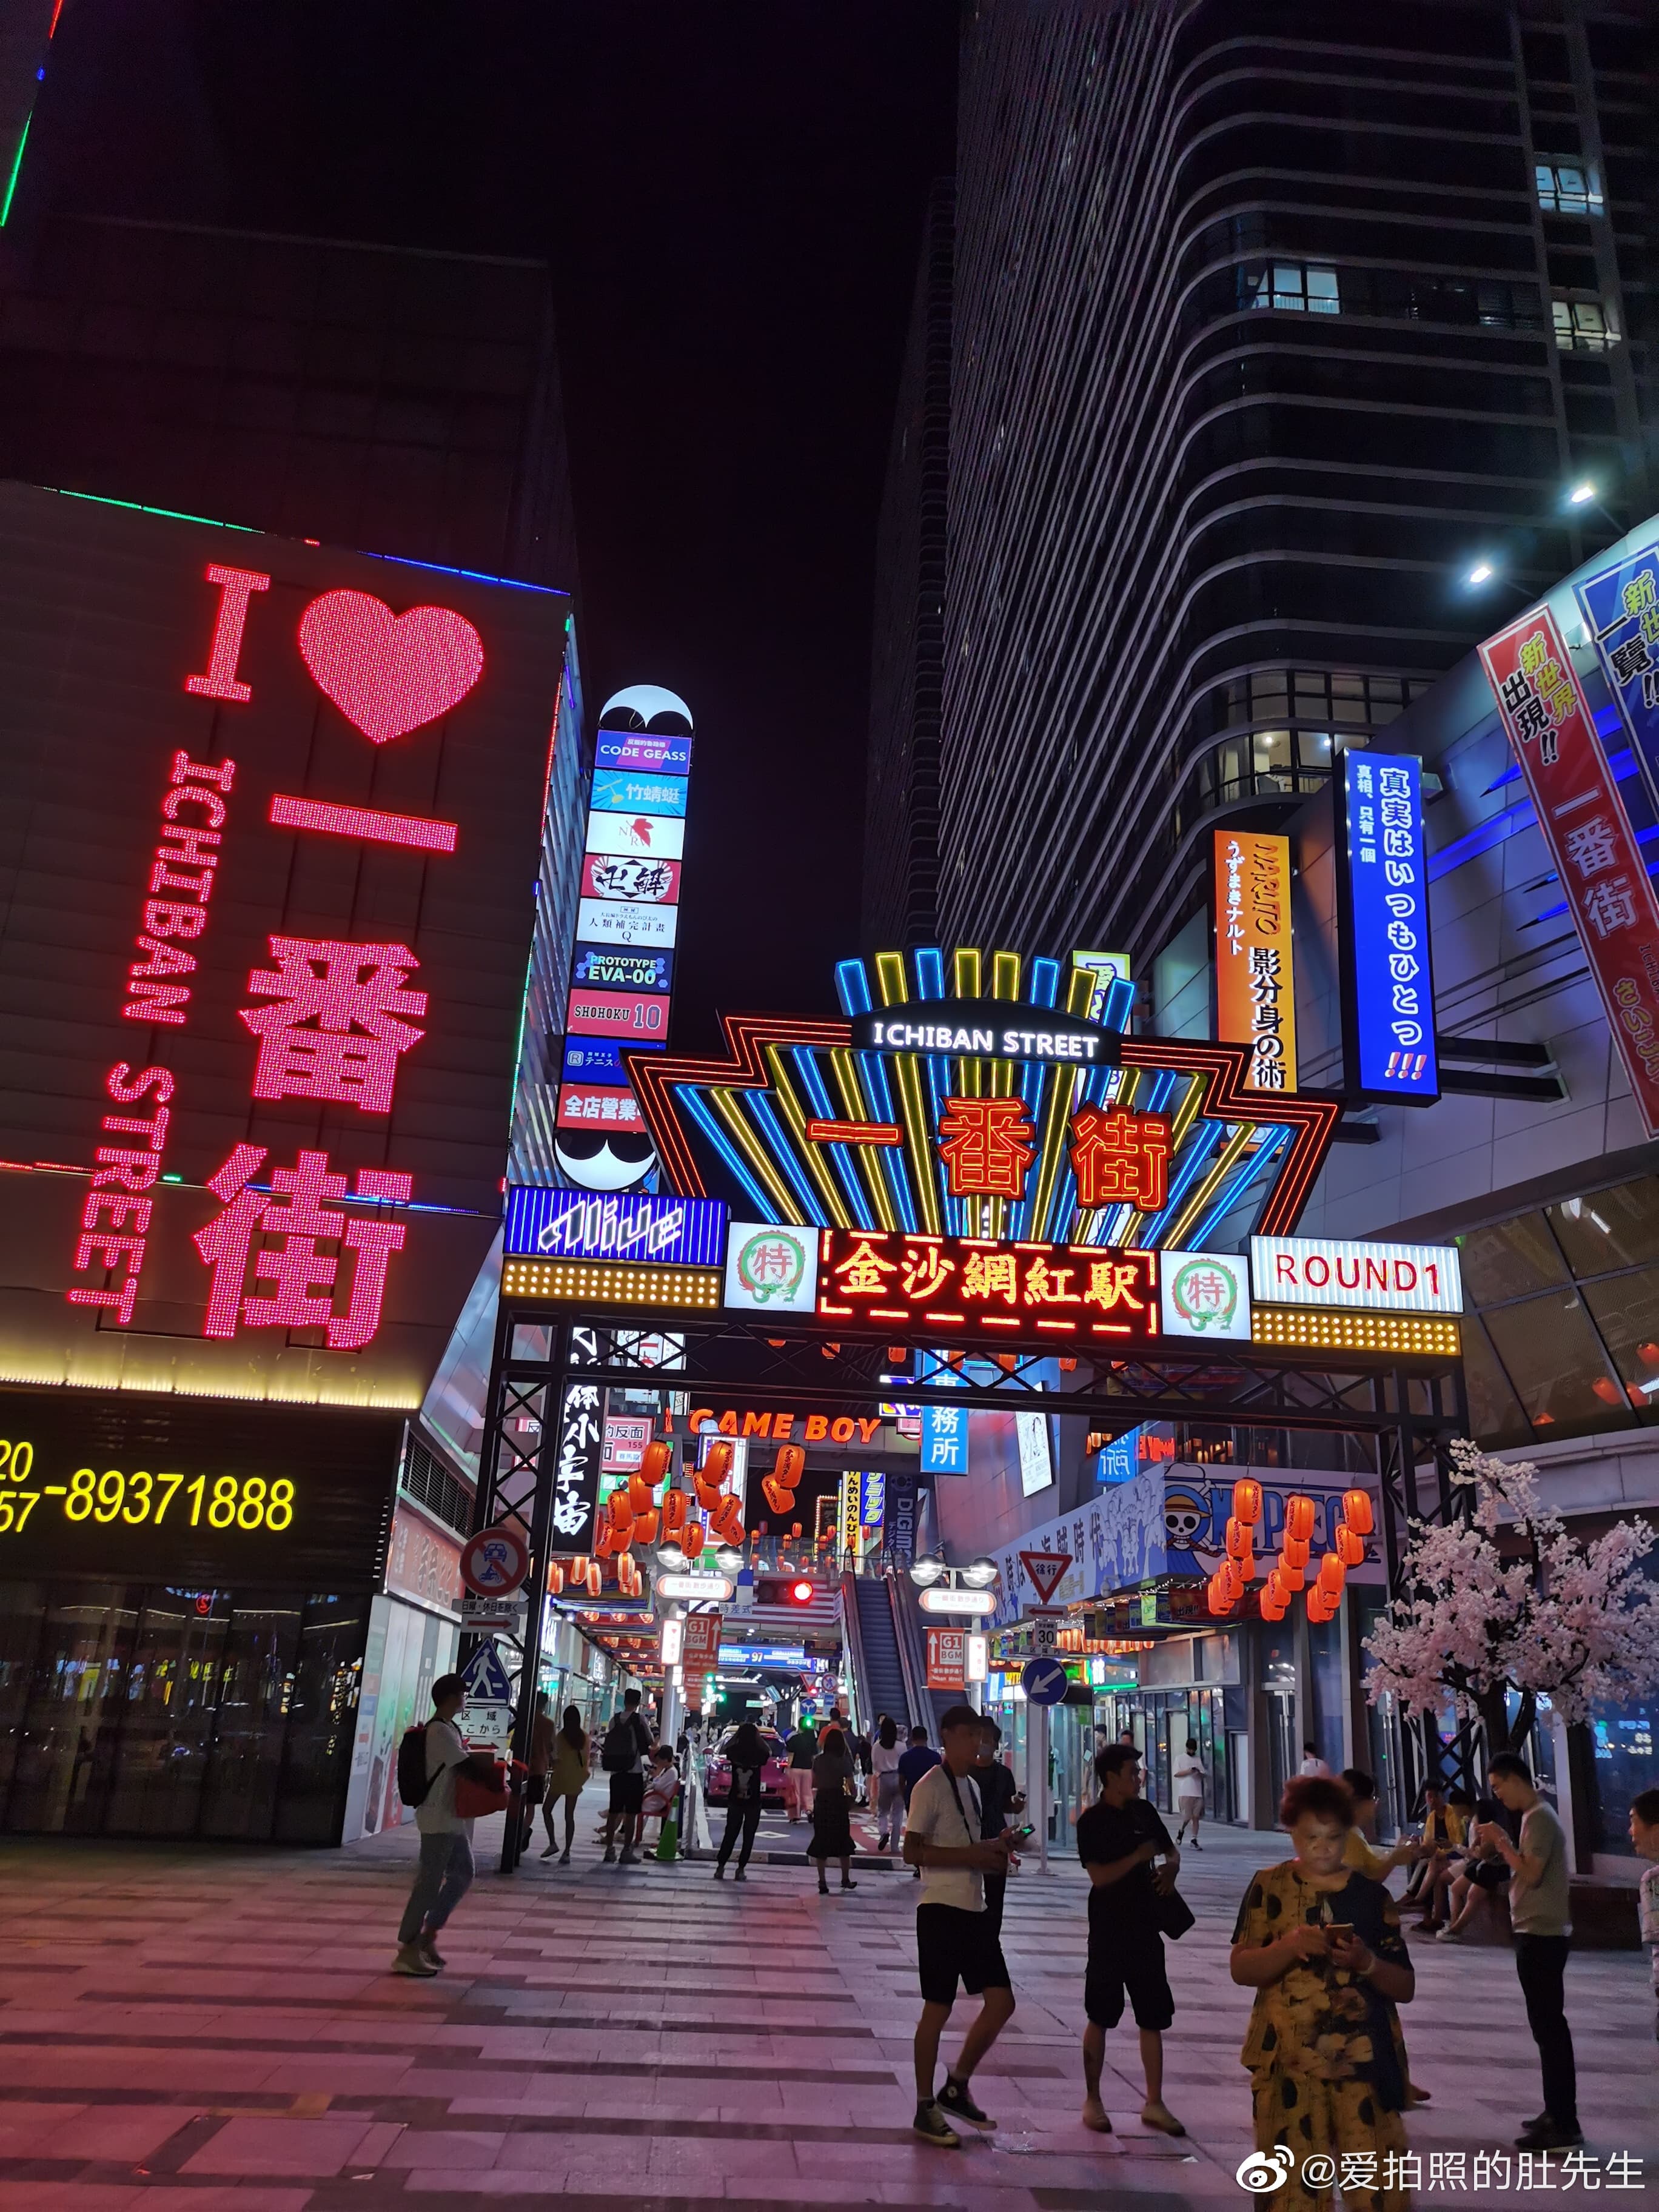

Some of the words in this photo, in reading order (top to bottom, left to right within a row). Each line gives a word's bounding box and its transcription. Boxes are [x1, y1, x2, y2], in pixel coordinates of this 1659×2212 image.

[186, 563, 271, 703] I
[1520, 631, 1578, 726] 新世界
[1501, 670, 1559, 766] 出現!!
[600, 745, 639, 757] CODE
[643, 749, 686, 762] GEASS
[626, 783, 680, 804] 竹蜻蜓
[1356, 763, 1377, 864] 真相、只有一個
[1552, 787, 1638, 939] 一番街
[123, 750, 236, 1025] ICHIBAN
[1225, 839, 1245, 956] うずまきナルト
[1251, 842, 1282, 936] NARUTO
[622, 931, 631, 942] Q
[588, 967, 656, 985] EVA-00
[589, 954, 657, 970] PROTOTYPE
[574, 1005, 631, 1021] SHOHOKU
[633, 1004, 662, 1029] 10
[1249, 945, 1286, 1090] 影分身の術
[874, 1022, 993, 1051] ICHIBAN
[1003, 1031, 1099, 1057] STREET
[192, 794, 458, 1349] 一番街
[564, 1094, 641, 1121] 全店營業
[805, 1096, 1175, 1210] 一番街
[67, 1062, 175, 1324] STREET
[753, 1243, 793, 1280] 特
[835, 1239, 1145, 1311] 金沙網紅駅
[1186, 1270, 1226, 1309] 特
[689, 1408, 794, 1438] GAME
[804, 1415, 882, 1444] BOY
[1035, 1563, 1057, 1576] 徐行
[688, 1620, 705, 1633] G1
[720, 1604, 752, 1614] 時差式
[686, 1635, 706, 1644] BGM
[942, 1636, 960, 1648] G1
[1038, 1630, 1054, 1644] 30
[751, 1651, 763, 1662] 97
[941, 1651, 962, 1659] BGM
[461, 1710, 497, 1721] 区域
